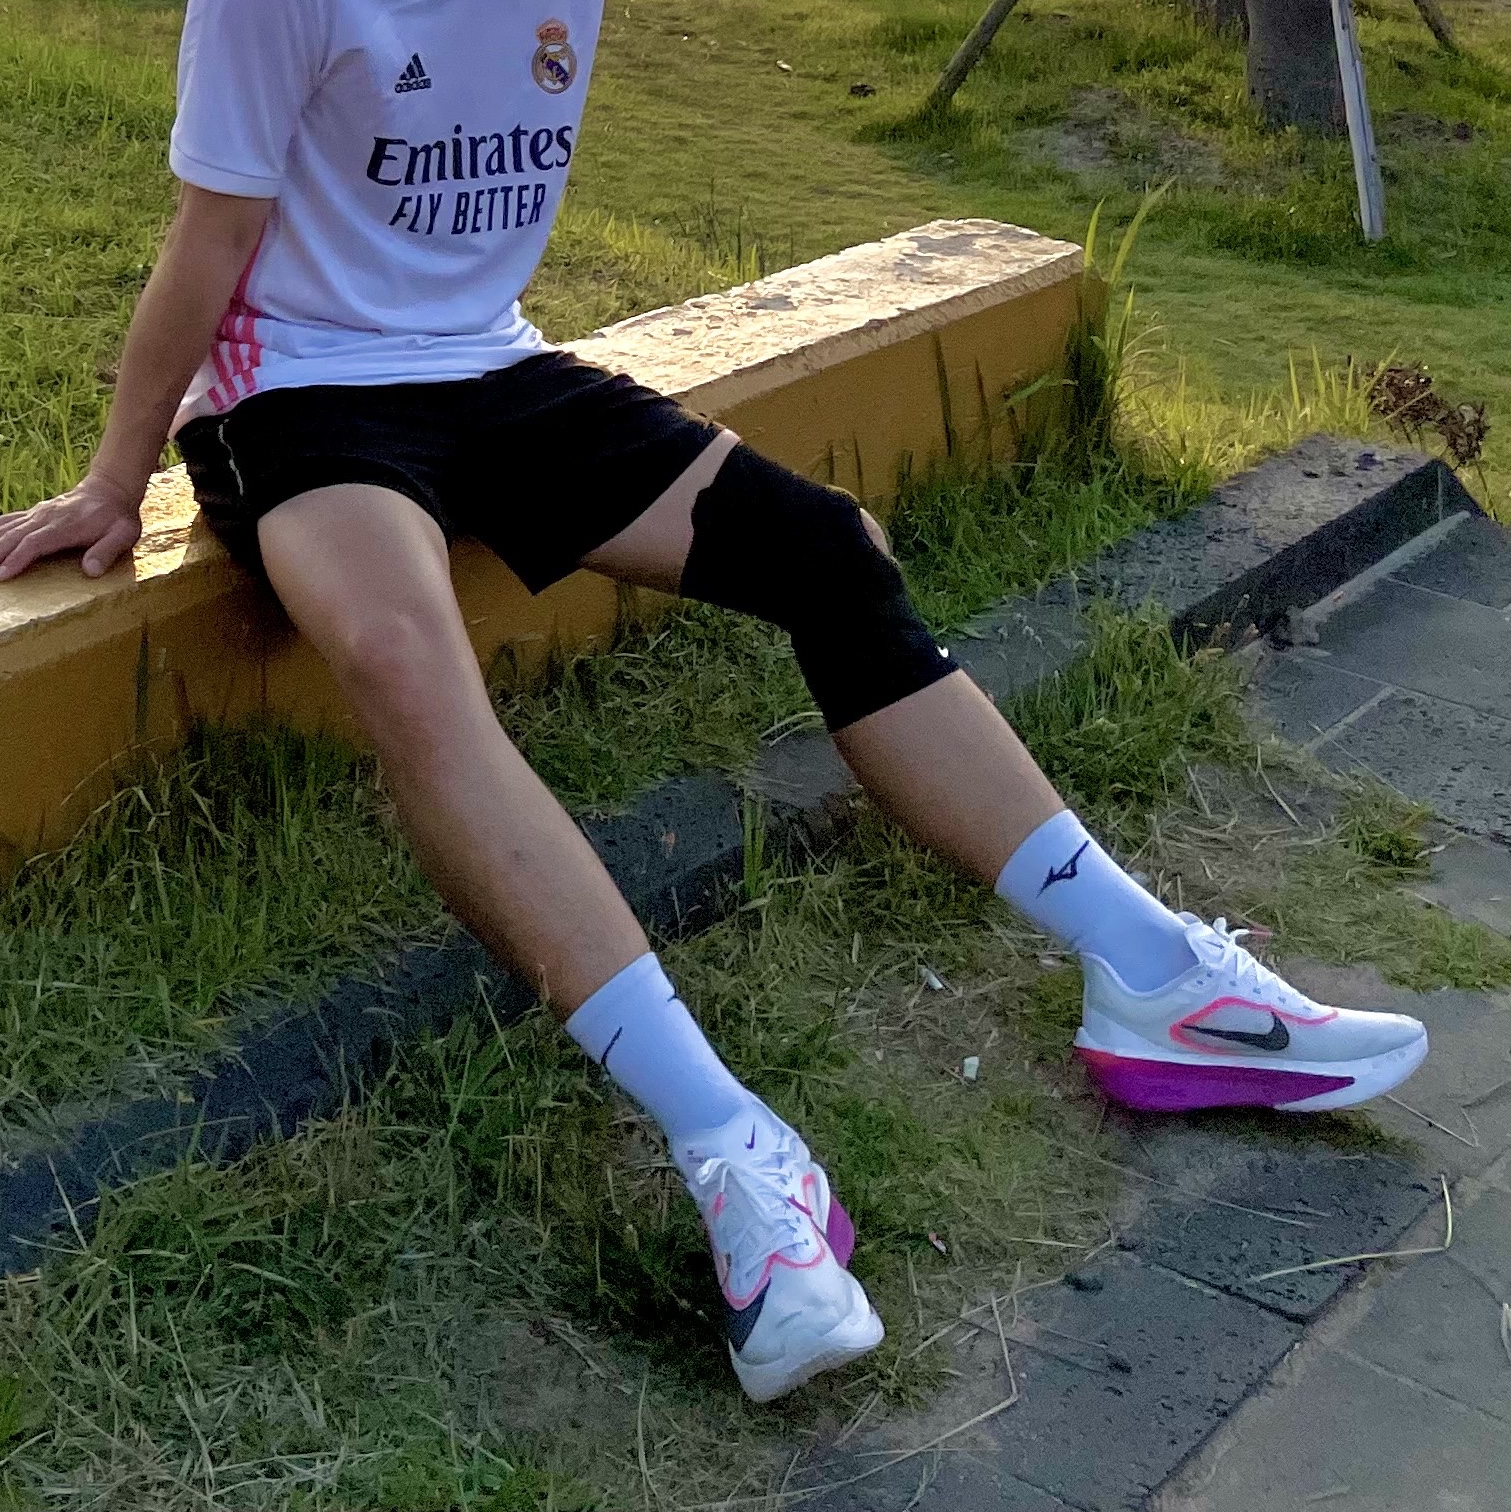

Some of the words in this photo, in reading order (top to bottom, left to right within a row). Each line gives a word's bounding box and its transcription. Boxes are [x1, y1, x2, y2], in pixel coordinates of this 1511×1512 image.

[394, 78, 431, 93] adidas
[366, 123, 573, 186] Emirates
[388, 191, 444, 236] FLY
[450, 182, 547, 236] BETTER
